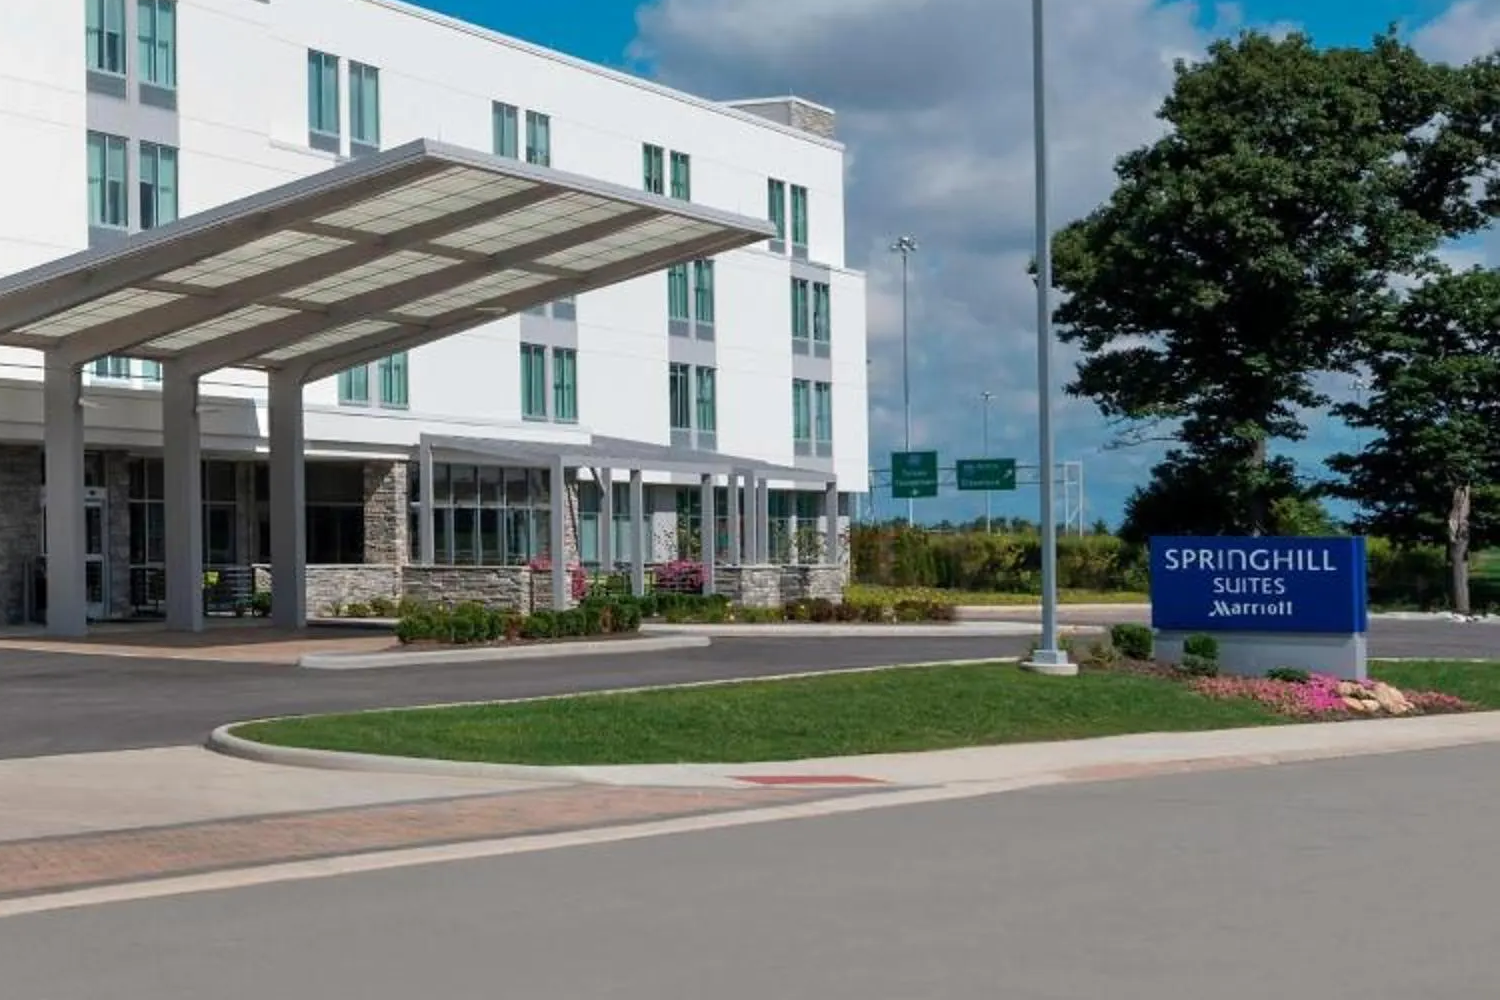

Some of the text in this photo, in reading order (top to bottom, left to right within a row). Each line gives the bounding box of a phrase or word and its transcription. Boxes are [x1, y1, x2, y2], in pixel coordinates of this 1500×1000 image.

[1165, 549, 1337, 571] SPRINGHILL
[1213, 577, 1286, 595] SUITES
[1208, 601, 1293, 617] Marriott
